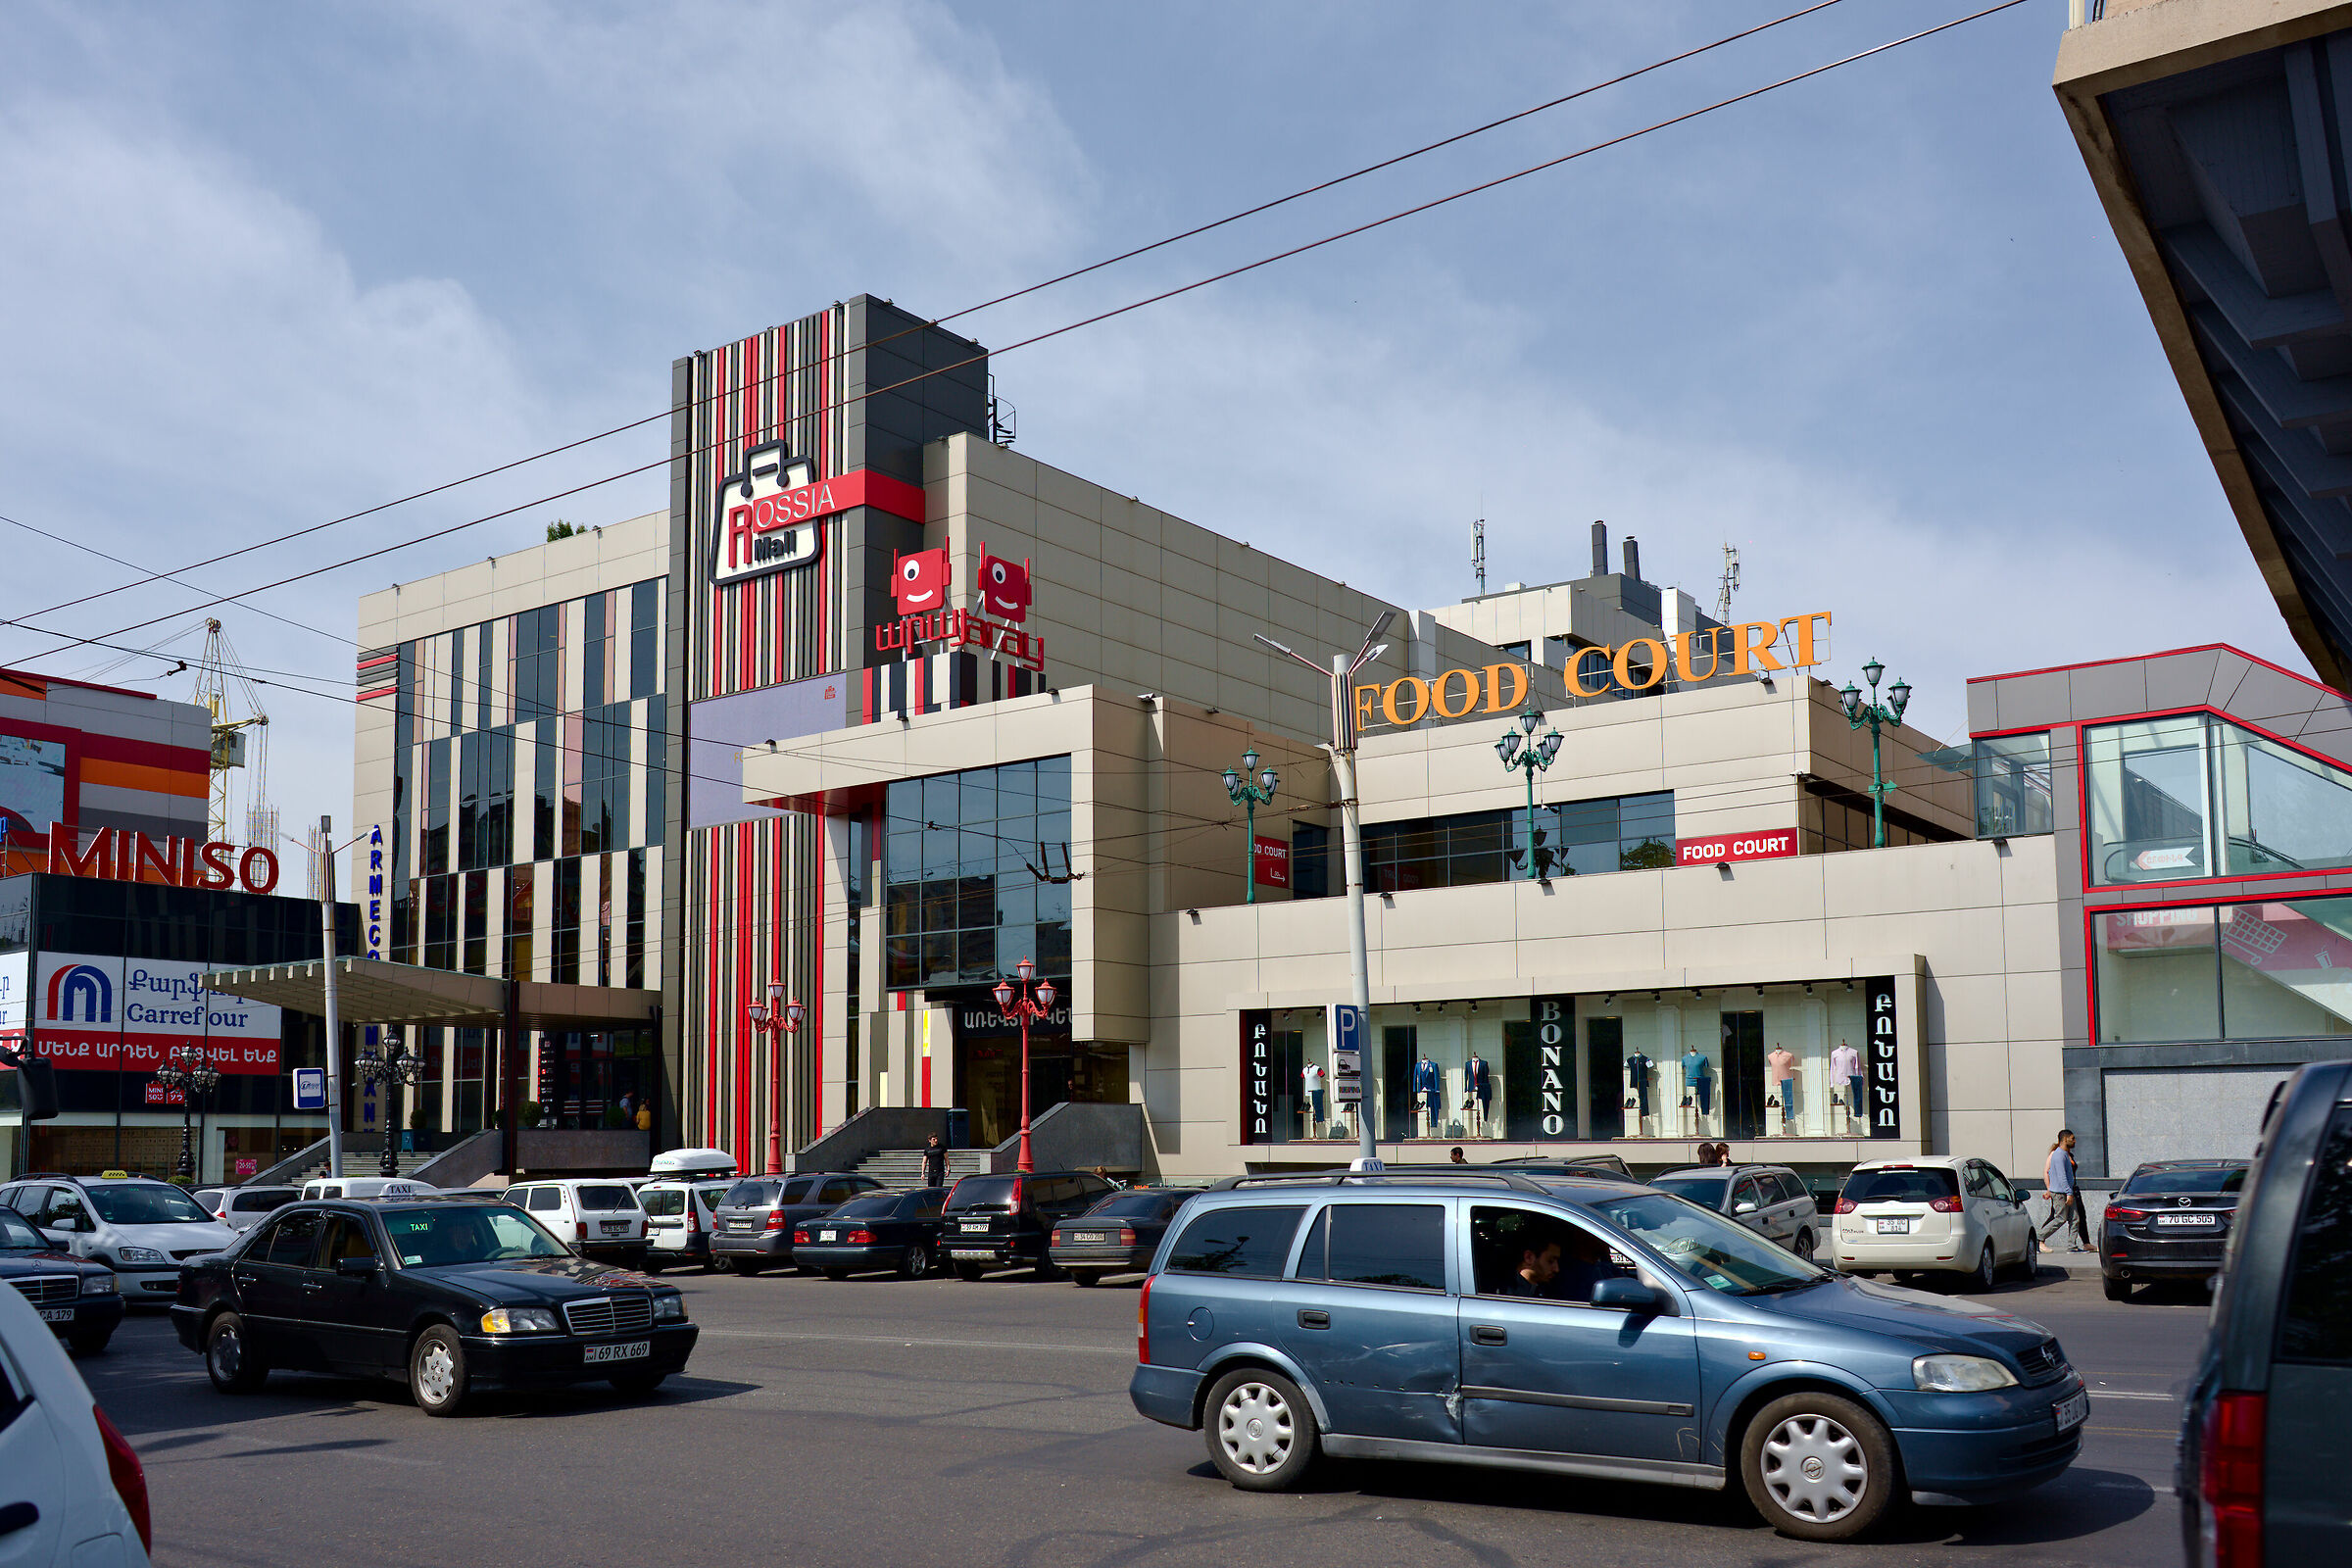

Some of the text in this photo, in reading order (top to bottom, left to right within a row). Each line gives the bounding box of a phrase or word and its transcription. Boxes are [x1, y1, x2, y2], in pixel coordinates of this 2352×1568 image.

[754, 529, 798, 563] Mall
[1354, 612, 1833, 732] FOOD COURT
[48, 821, 279, 894] MINISO
[1264, 846, 1287, 858] COURT
[1683, 837, 1789, 860] FOOD COURT
[126, 1003, 249, 1028] Carrefour
[1340, 1007, 1356, 1047] P
[38, 1041, 90, 1056] ՄԵՆՔ
[96, 1043, 160, 1058] ԱՐԴԵՆ
[244, 1049, 277, 1063] ԵՆՔ
[1541, 1001, 1565, 1135] BONANO
[1363, 1161, 1383, 1171] TAXI
[389, 1185, 412, 1194] TAXI
[410, 1223, 429, 1232] TAXI
[2168, 1214, 2180, 1223] 70
[55, 1309, 73, 1320] 179
[598, 1343, 648, 1360] 69 RX 669
